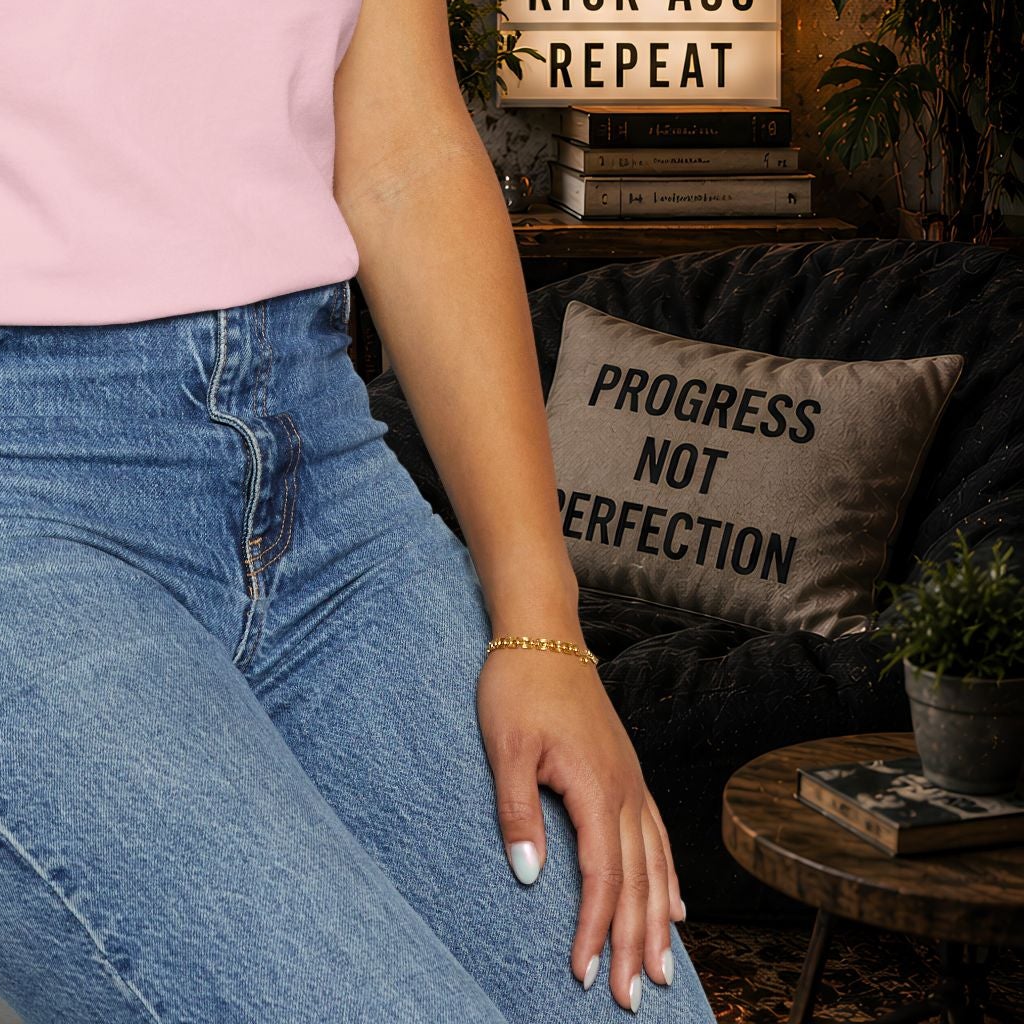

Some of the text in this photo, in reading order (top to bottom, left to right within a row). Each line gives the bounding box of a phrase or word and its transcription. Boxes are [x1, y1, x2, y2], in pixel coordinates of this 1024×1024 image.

[549, 42, 733, 88] REPEAT
[588, 363, 822, 444] PROGRESS
[633, 436, 729, 495] NOT
